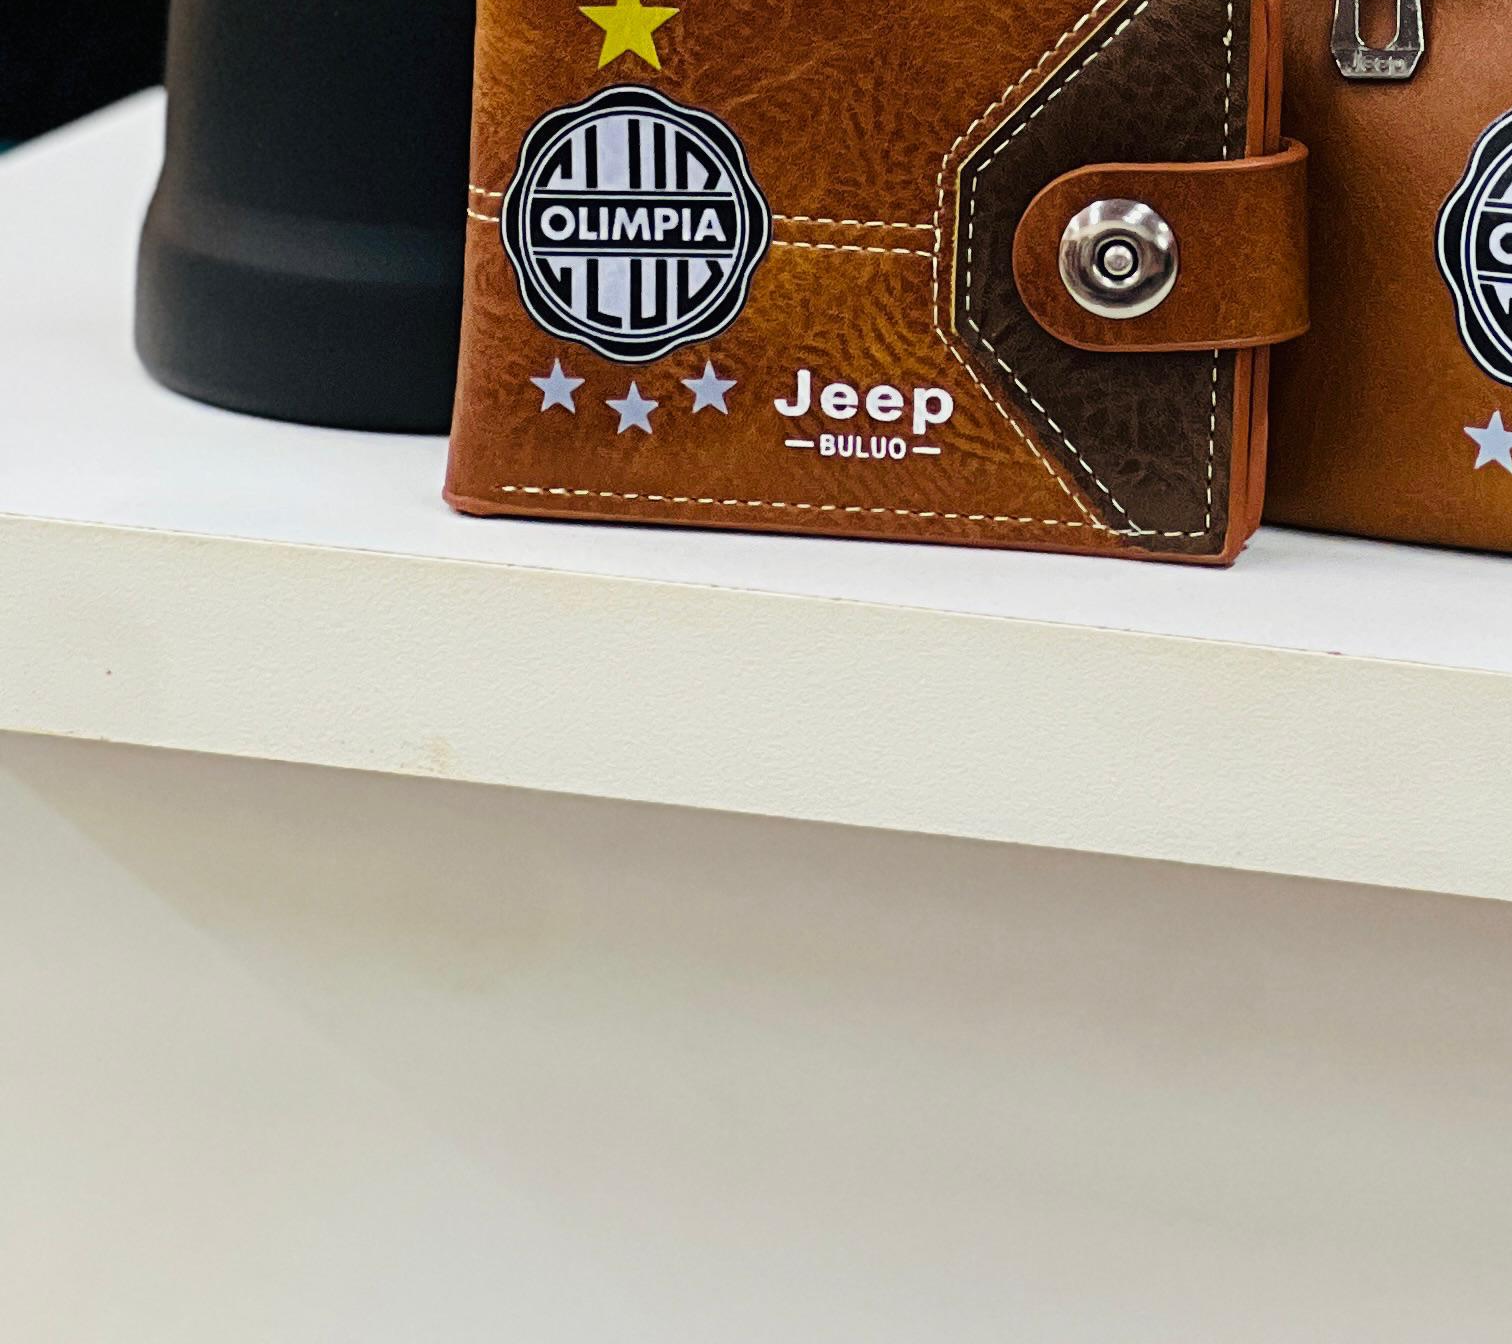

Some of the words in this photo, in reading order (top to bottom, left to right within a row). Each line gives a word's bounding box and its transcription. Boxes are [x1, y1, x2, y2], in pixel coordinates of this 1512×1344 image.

[540, 204, 728, 243] OLIMPIA
[773, 368, 955, 436] Jeep
[819, 433, 908, 461] BULUO
